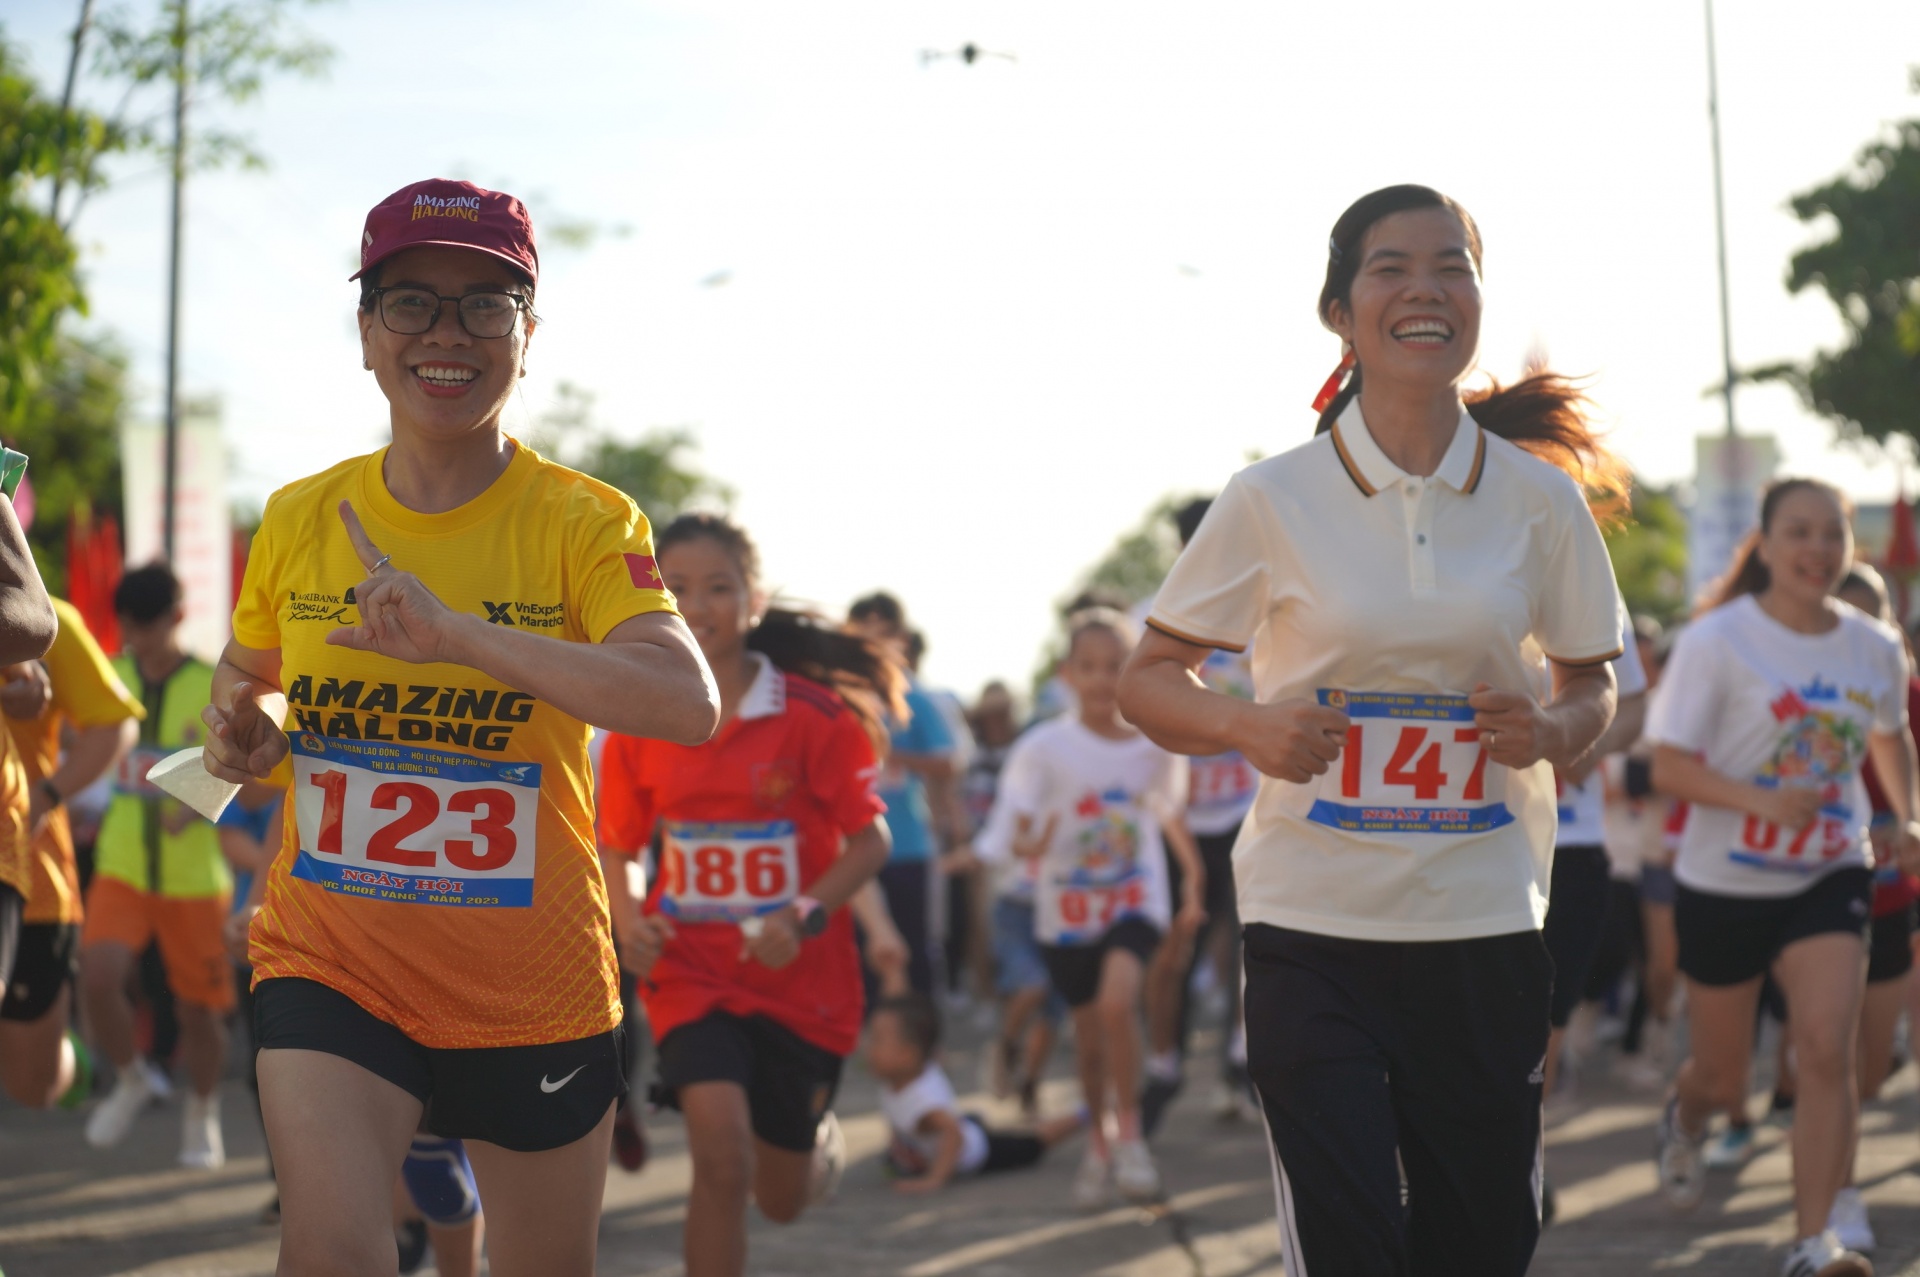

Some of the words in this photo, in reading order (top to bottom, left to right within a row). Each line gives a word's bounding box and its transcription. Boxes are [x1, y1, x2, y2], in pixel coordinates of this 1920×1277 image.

[411, 205, 479, 222] HALONG
[413, 194, 480, 210] AMAZING
[288, 674, 536, 723] AMAZING
[295, 708, 514, 752] HALONG
[363, 746, 377, 756] LAO
[1341, 724, 1489, 800] 147
[311, 769, 517, 871] 123
[342, 868, 409, 889] NGÀY
[415, 878, 464, 894] HỘI
[466, 897, 499, 905] 2023
